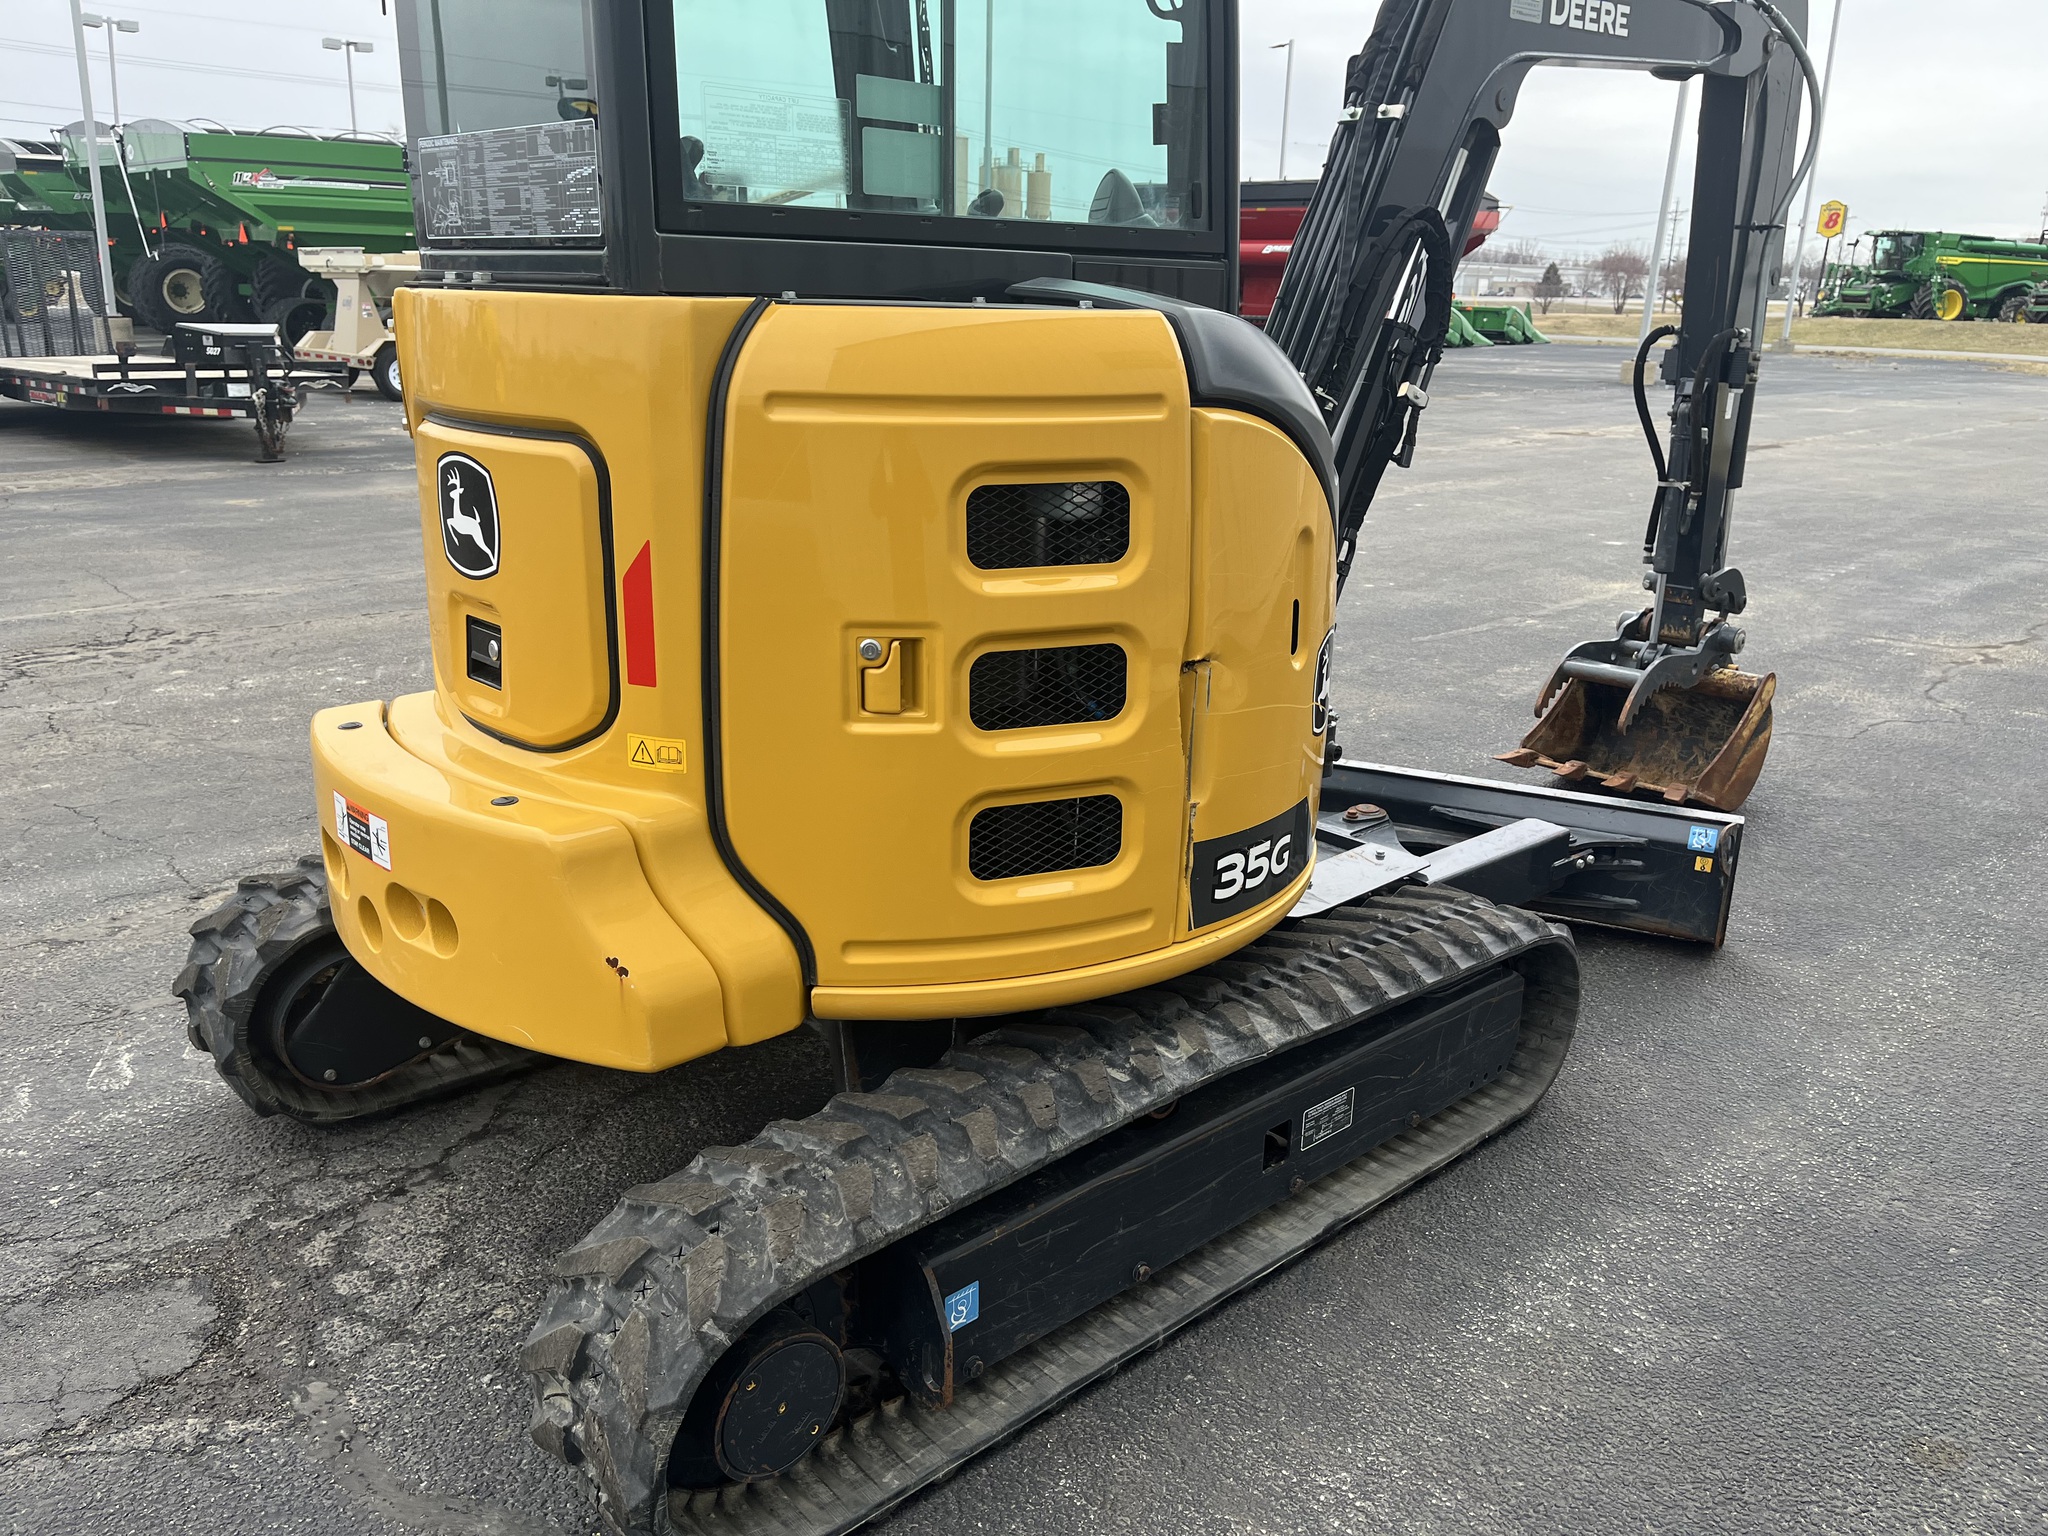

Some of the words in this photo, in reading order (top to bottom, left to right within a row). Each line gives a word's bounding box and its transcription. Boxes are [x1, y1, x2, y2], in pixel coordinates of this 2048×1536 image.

[1549, 0, 1631, 37] DEERE
[1824, 212, 1841, 229] 8
[205, 346, 221, 356] 5027
[1213, 834, 1292, 900] 35G
